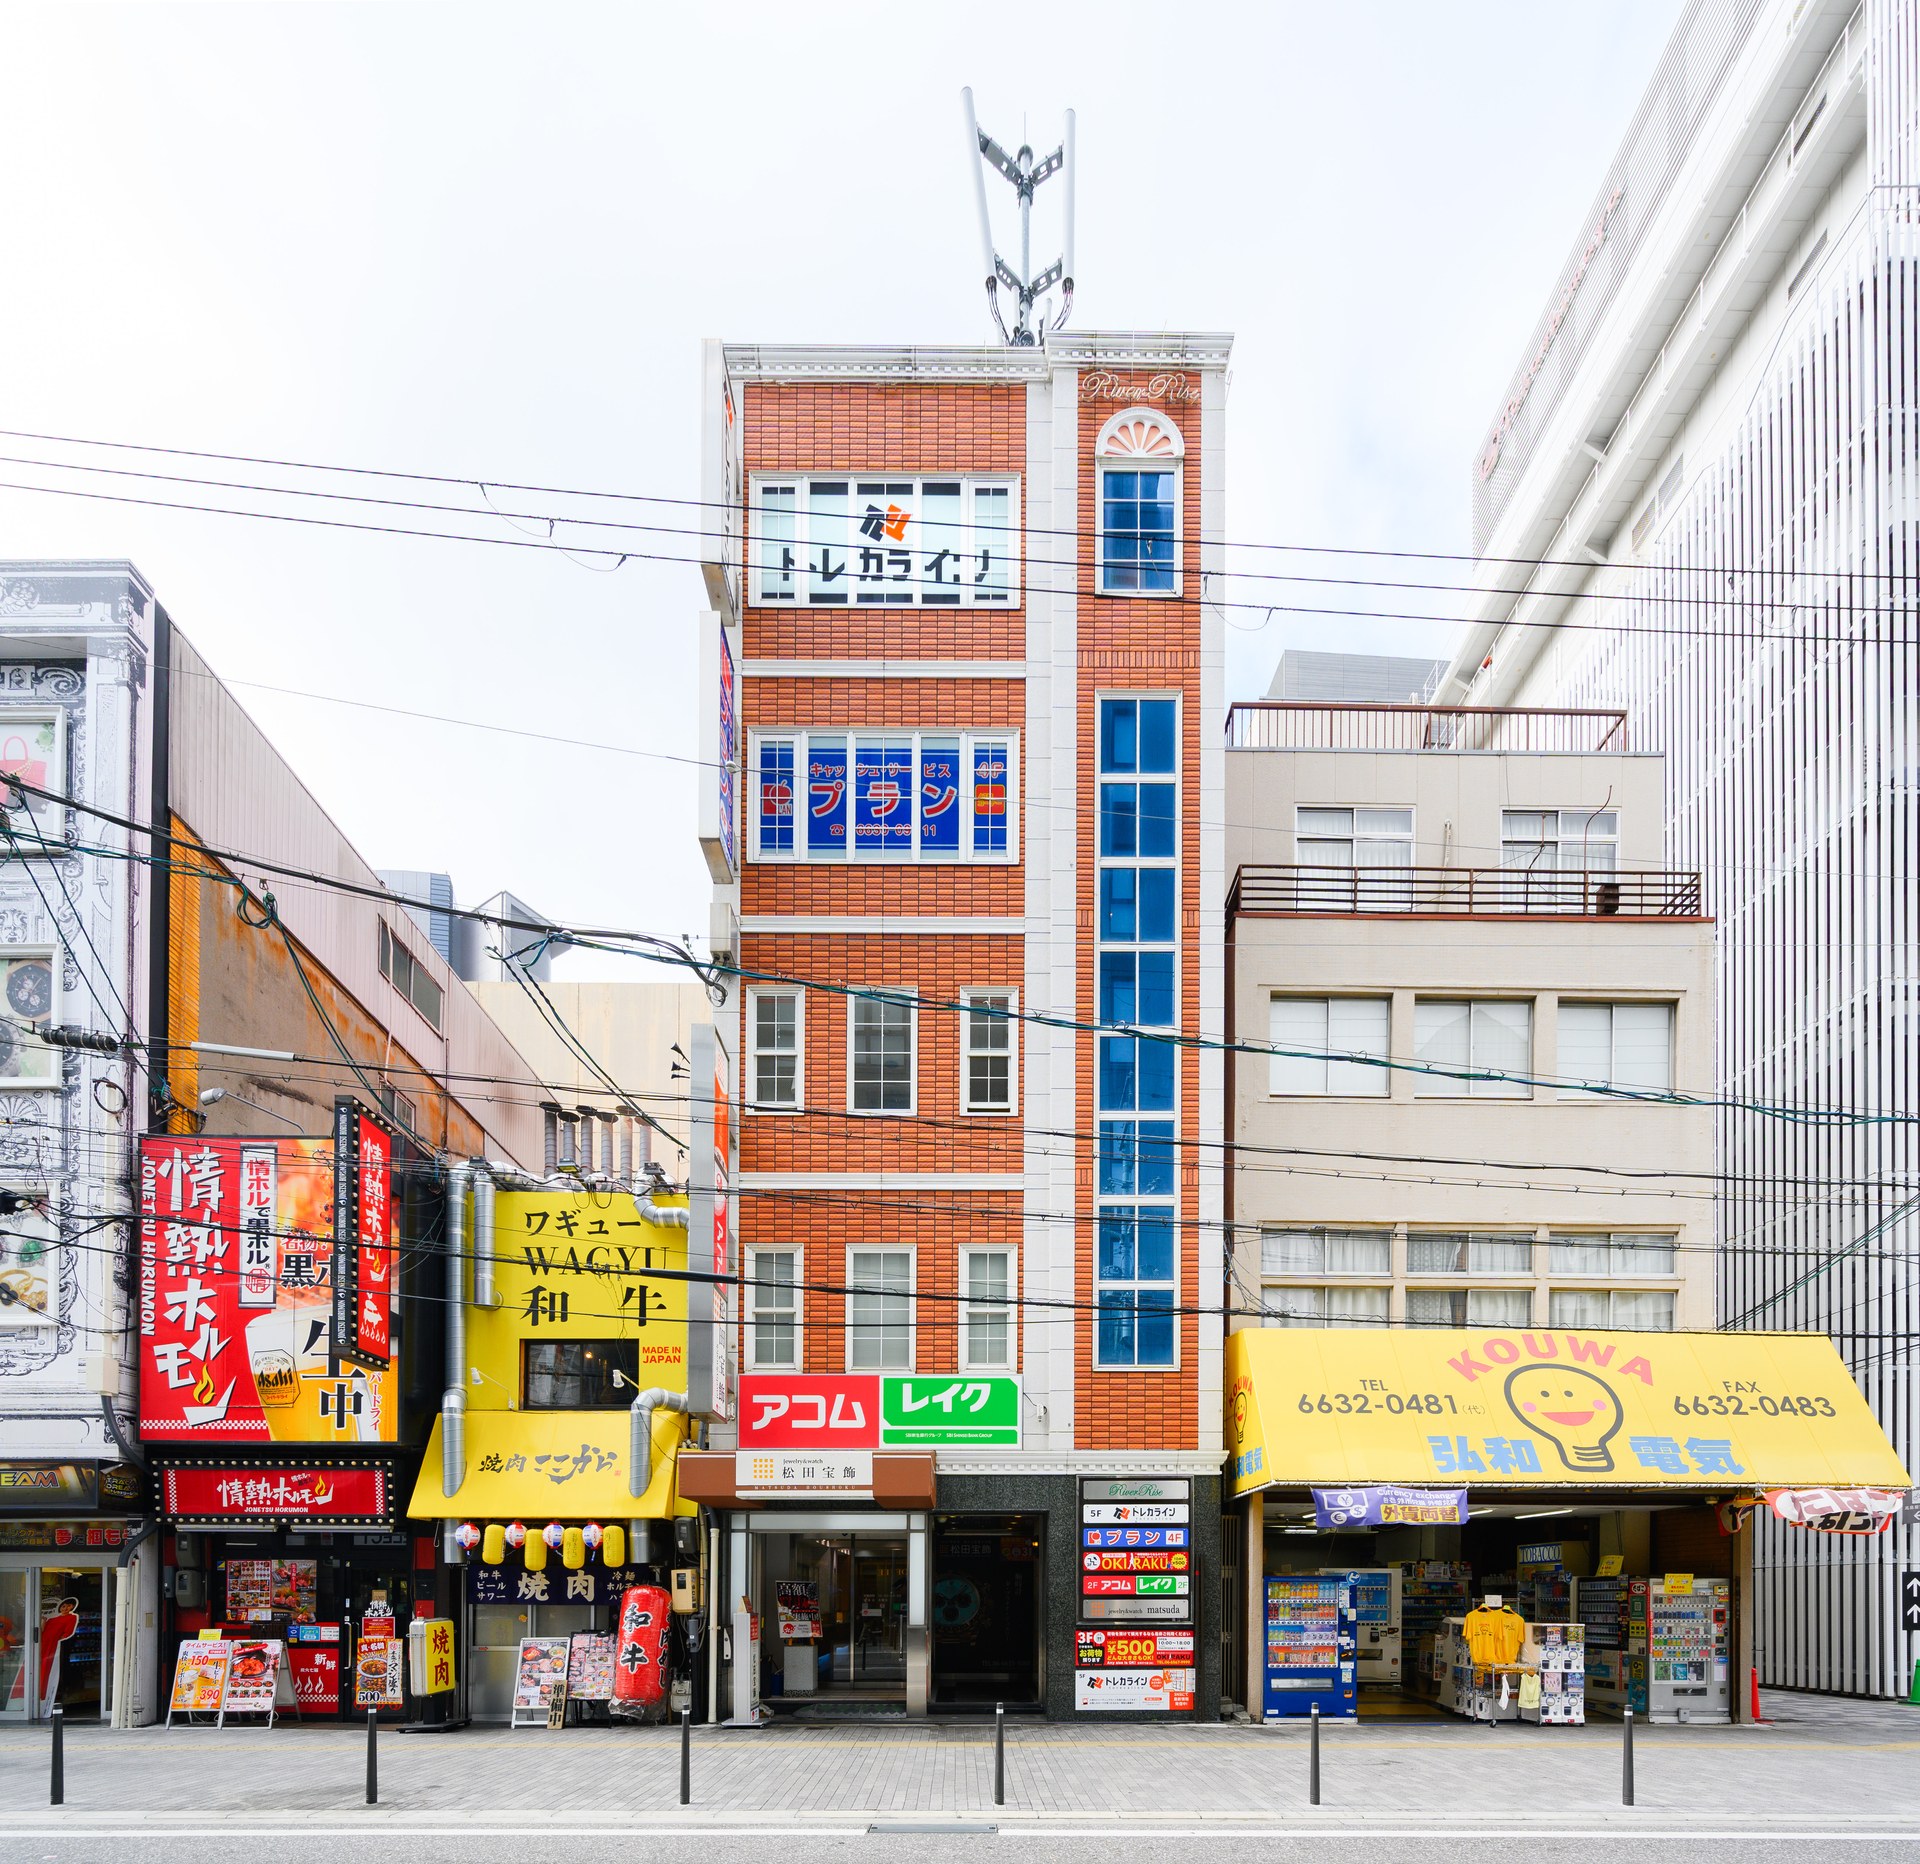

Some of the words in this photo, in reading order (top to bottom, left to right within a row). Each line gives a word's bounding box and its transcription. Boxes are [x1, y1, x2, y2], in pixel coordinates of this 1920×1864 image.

[810, 780, 957, 818] プラン
[524, 1209, 641, 1237] ワギュー
[520, 1246, 670, 1276] WAGYU
[141, 1241, 157, 1337] HORUMON
[520, 1284, 668, 1327] 和牛
[642, 1346, 669, 1355] MADE
[671, 1346, 682, 1354] IN
[642, 1355, 681, 1364] JAPAN
[1447, 1333, 1656, 1387] KOUWA
[257, 1367, 294, 1388] Asahi
[1359, 1379, 1388, 1392] TEL
[1723, 1380, 1761, 1393] FAX
[902, 1383, 991, 1413] レイク
[1298, 1393, 1457, 1416] 6632-0481
[752, 1393, 866, 1430] アコム
[1673, 1394, 1837, 1419] 6632-0483
[1427, 1435, 1544, 1476] 弘和
[1629, 1435, 1746, 1476] 電気
[477, 1453, 527, 1474] 焼肉
[782, 1466, 856, 1479] 松田宝飾
[1108, 1483, 1139, 1497] River
[1138, 1483, 1164, 1497] Rise
[1377, 1489, 1414, 1499] Currency
[1416, 1490, 1457, 1500] exchange
[1090, 1509, 1102, 1518] 5F
[1132, 1507, 1176, 1517] トレカライン
[1383, 1506, 1457, 1522] 外貨両替
[1106, 1529, 1161, 1545] プラン
[1167, 1533, 1182, 1542] 4F
[1521, 1546, 1561, 1562] TOBACCO
[478, 1570, 502, 1580] 和牛
[477, 1581, 507, 1590] ビール
[517, 1569, 595, 1602] 焼肉
[1087, 1581, 1098, 1589] 2F
[1101, 1580, 1132, 1590] アコム
[1139, 1578, 1173, 1590] レイク
[1177, 1581, 1188, 1589] 2F
[477, 1592, 506, 1601] サワー
[1147, 1604, 1180, 1614] matsuda
[620, 1603, 653, 1674] 和牛
[1078, 1631, 1093, 1644] 3F
[1079, 1649, 1103, 1658] お荷物
[1107, 1640, 1155, 1655] ¥500
[191, 1655, 210, 1666] 150
[314, 1652, 337, 1672] 新鮮
[432, 1625, 450, 1687] 焼肉
[1105, 1676, 1148, 1686] トレカライン
[199, 1689, 220, 1700] 390
[549, 1683, 565, 1728] 準備中
